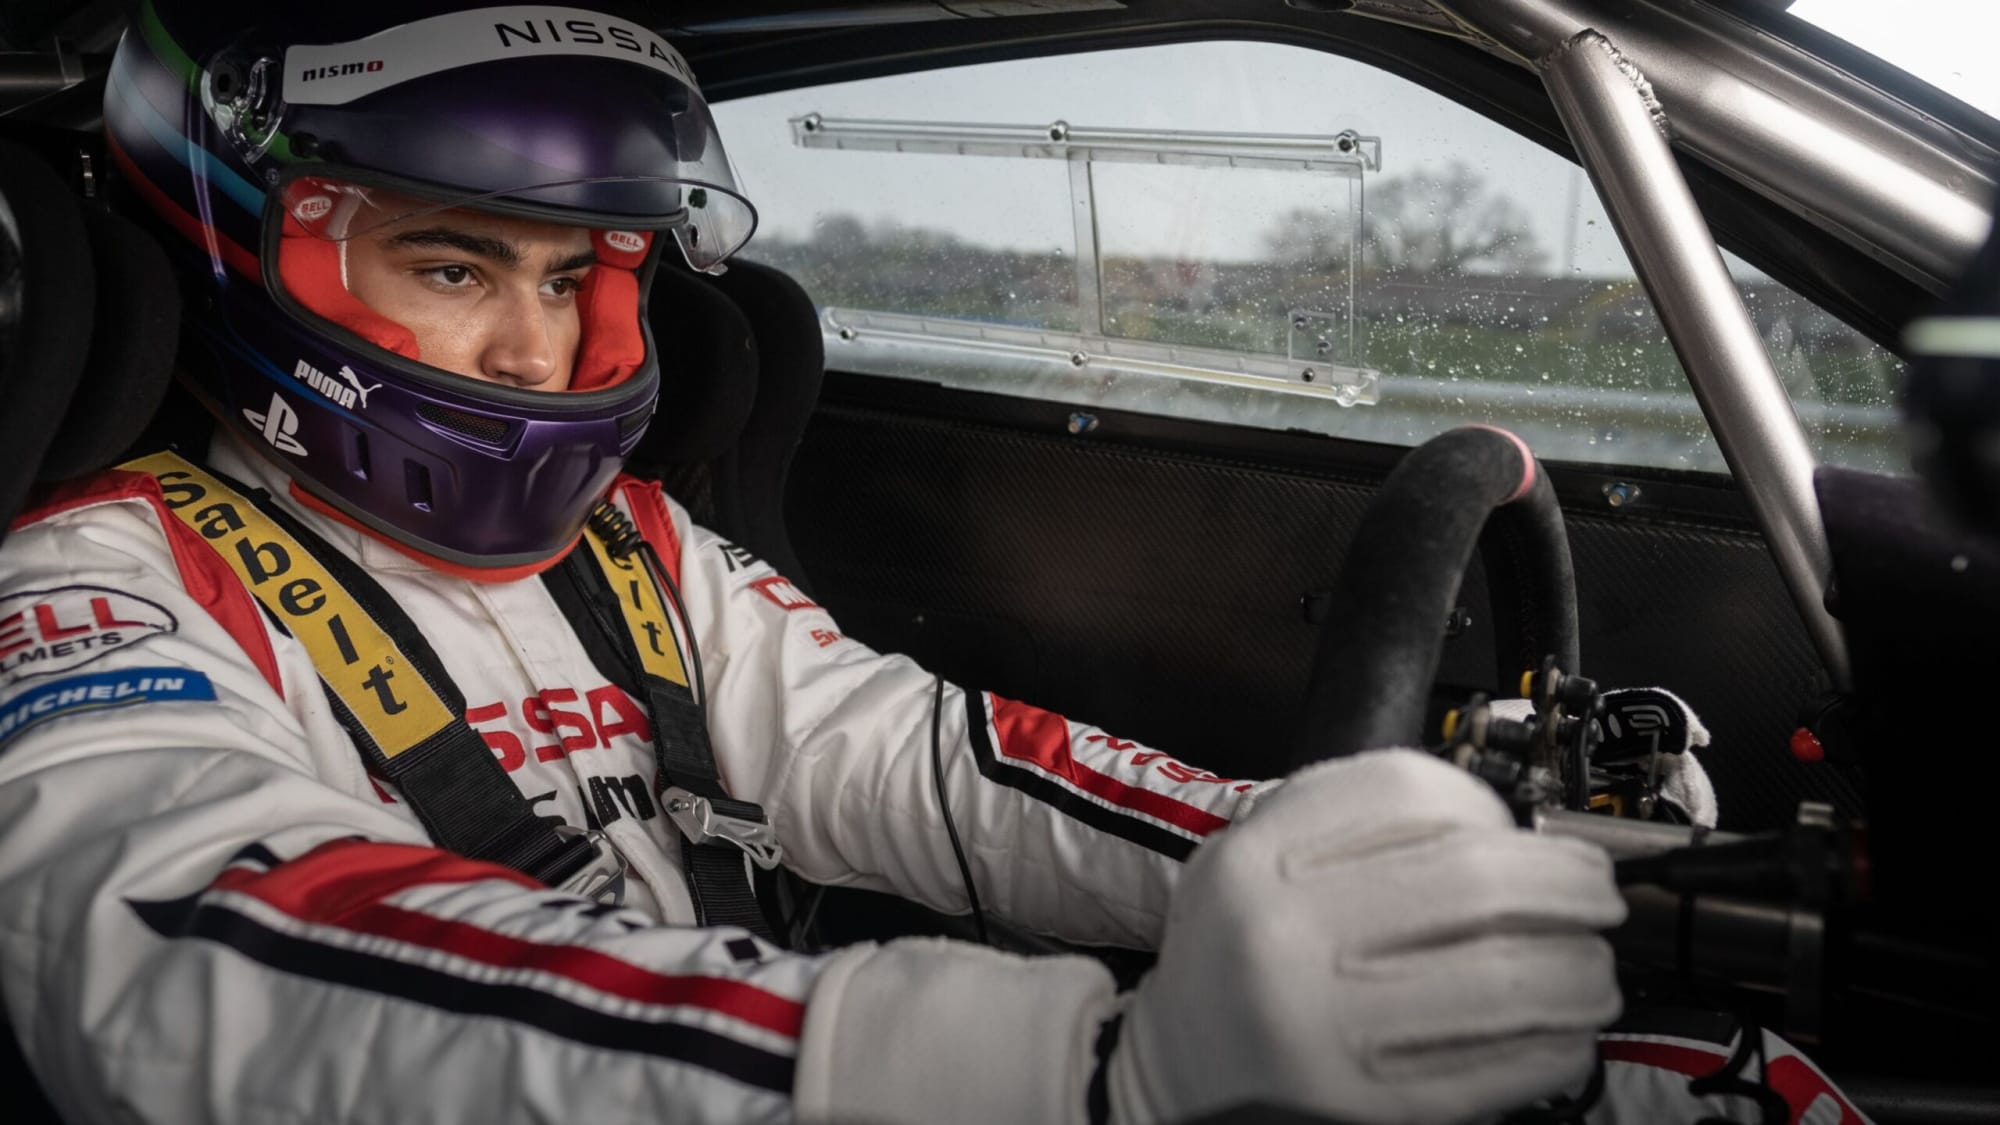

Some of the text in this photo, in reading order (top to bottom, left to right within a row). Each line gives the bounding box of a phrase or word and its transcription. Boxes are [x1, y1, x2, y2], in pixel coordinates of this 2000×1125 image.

[494, 20, 697, 87] NISSAN
[302, 199, 330, 212] BELL
[610, 231, 640, 247] BELL
[294, 359, 357, 410] PUMA
[0, 597, 146, 659] ELL
[0, 631, 123, 673] LMETS
